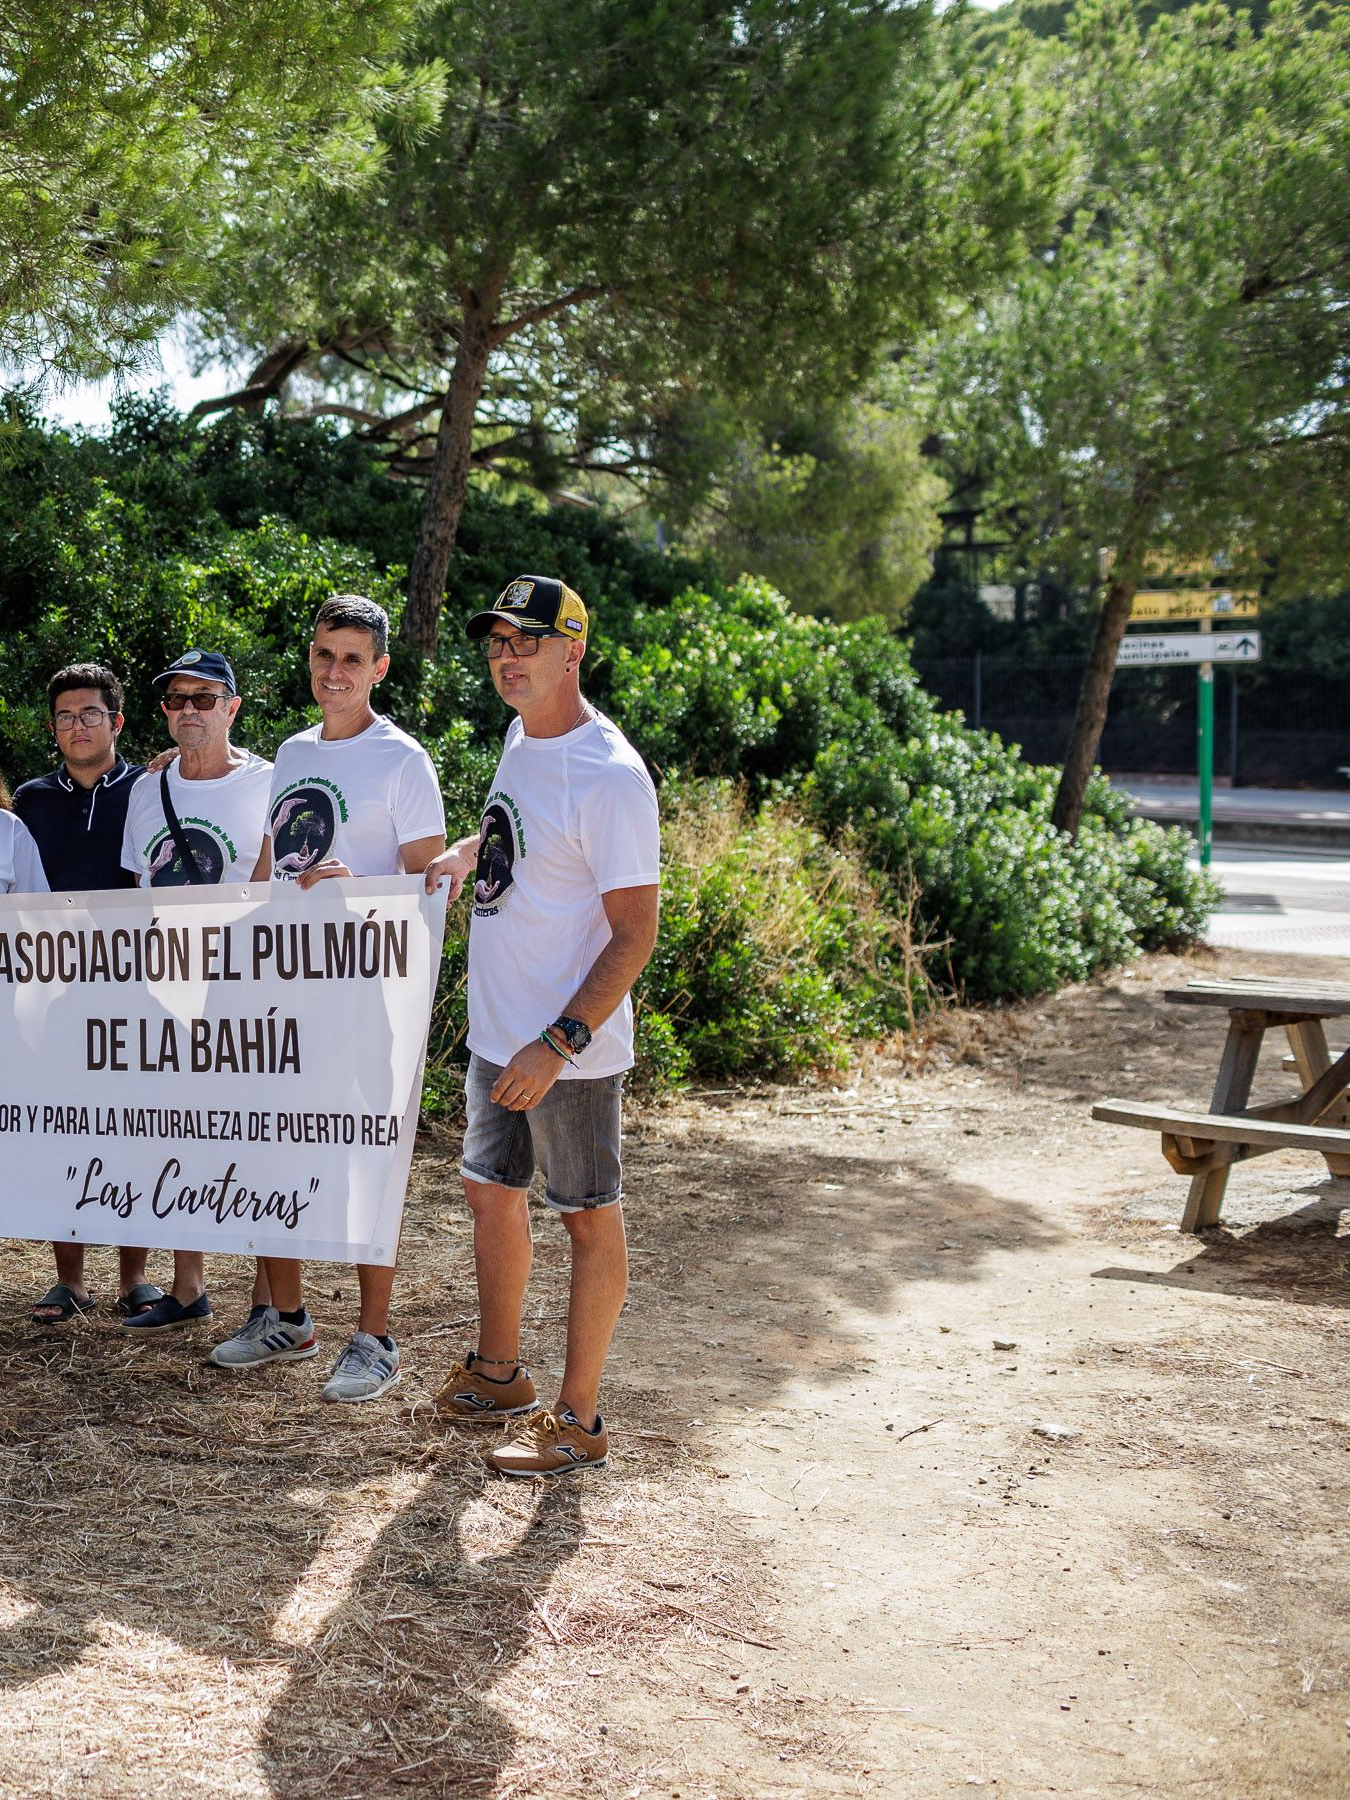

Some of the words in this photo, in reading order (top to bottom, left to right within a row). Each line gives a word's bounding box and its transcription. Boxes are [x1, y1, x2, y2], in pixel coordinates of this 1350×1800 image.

[201, 926, 241, 981] EL
[252, 908, 408, 981] PULMÓN
[86, 1018, 128, 1071] DE
[139, 1018, 180, 1073] LA
[191, 1006, 301, 1074] BAHÍA
[26, 1105, 38, 1133] Y
[43, 1105, 90, 1135] PARA
[95, 1107, 118, 1136] LA
[123, 1108, 243, 1141] NATURALEZA
[248, 1111, 271, 1142] DE
[277, 1112, 355, 1145] PUERTO
[361, 1114, 404, 1147] REA
[66, 1157, 142, 1219] "Las
[152, 1158, 320, 1230] Canteras"
